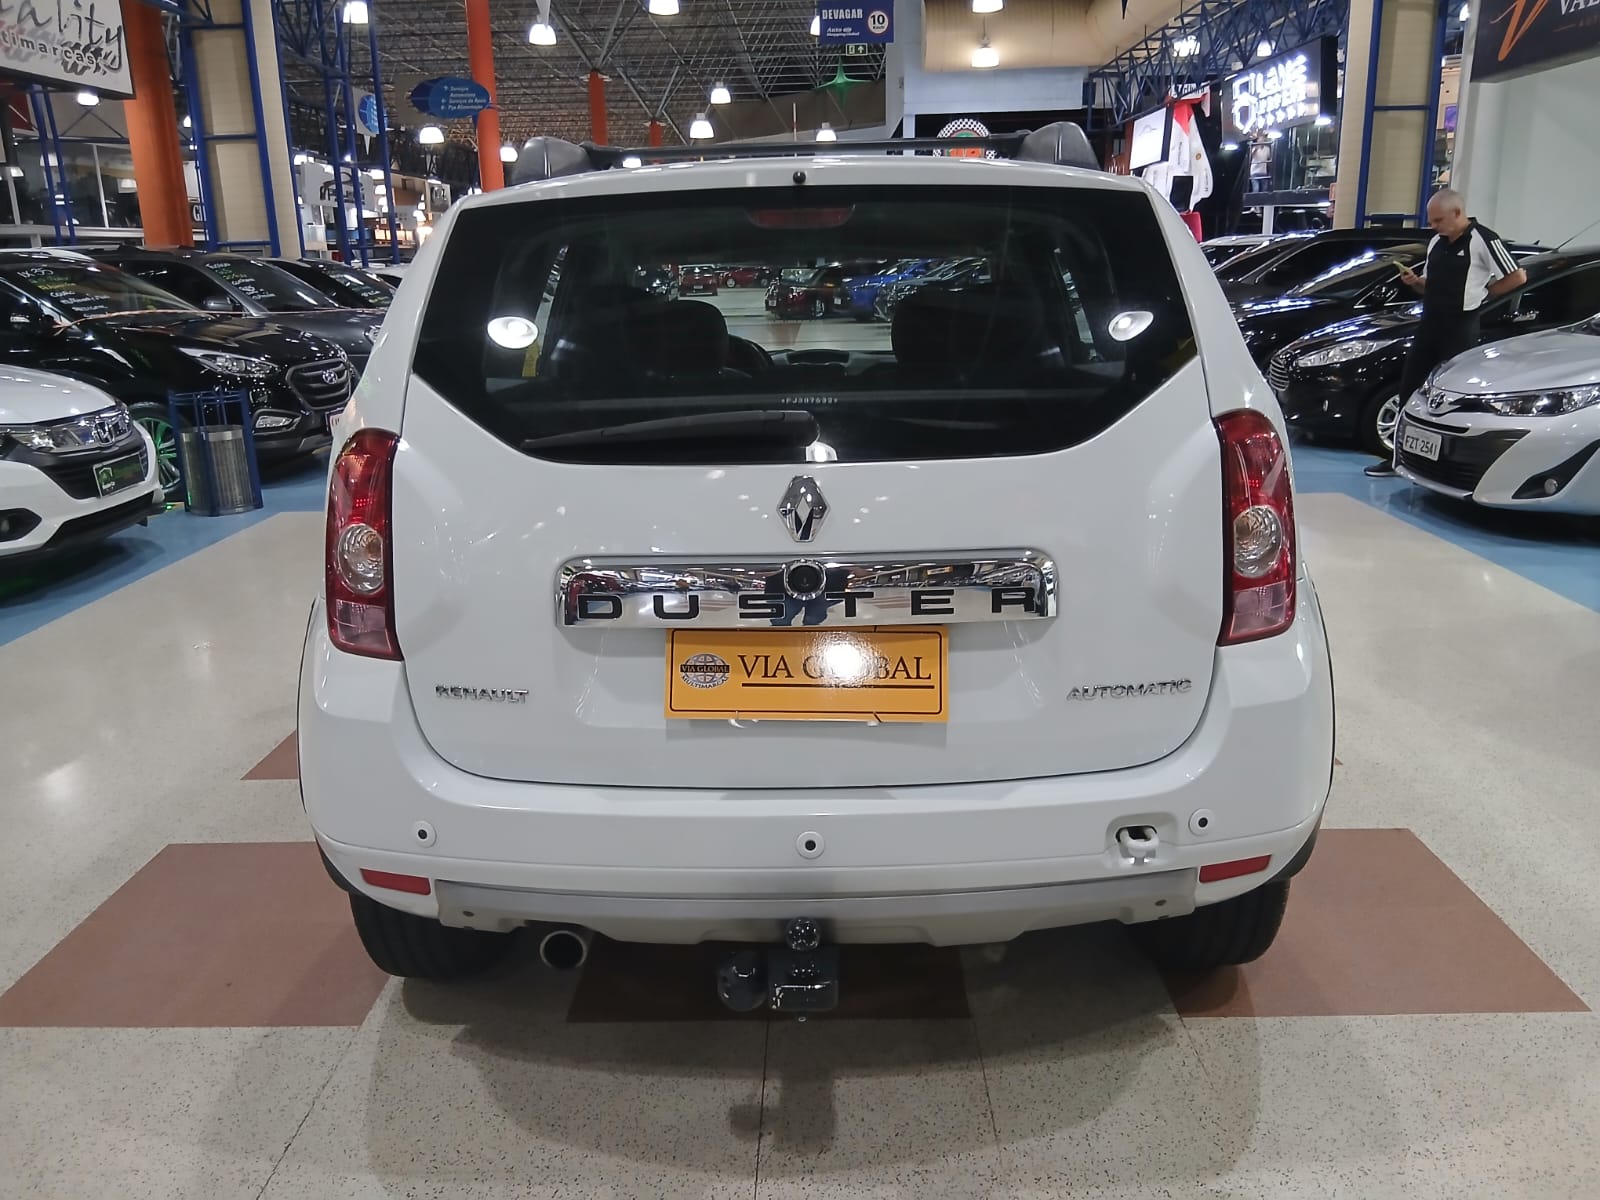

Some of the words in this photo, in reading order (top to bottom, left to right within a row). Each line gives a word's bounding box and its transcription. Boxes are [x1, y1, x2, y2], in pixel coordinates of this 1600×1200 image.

[821, 8, 863, 20] DEVAGAR
[870, 14, 886, 25] 10
[577, 587, 1037, 620] DUSTER
[681, 665, 696, 673] VIA
[737, 654, 795, 679] VIA
[435, 685, 529, 704] RENAULT
[1066, 678, 1192, 701] AUTOMATIC
